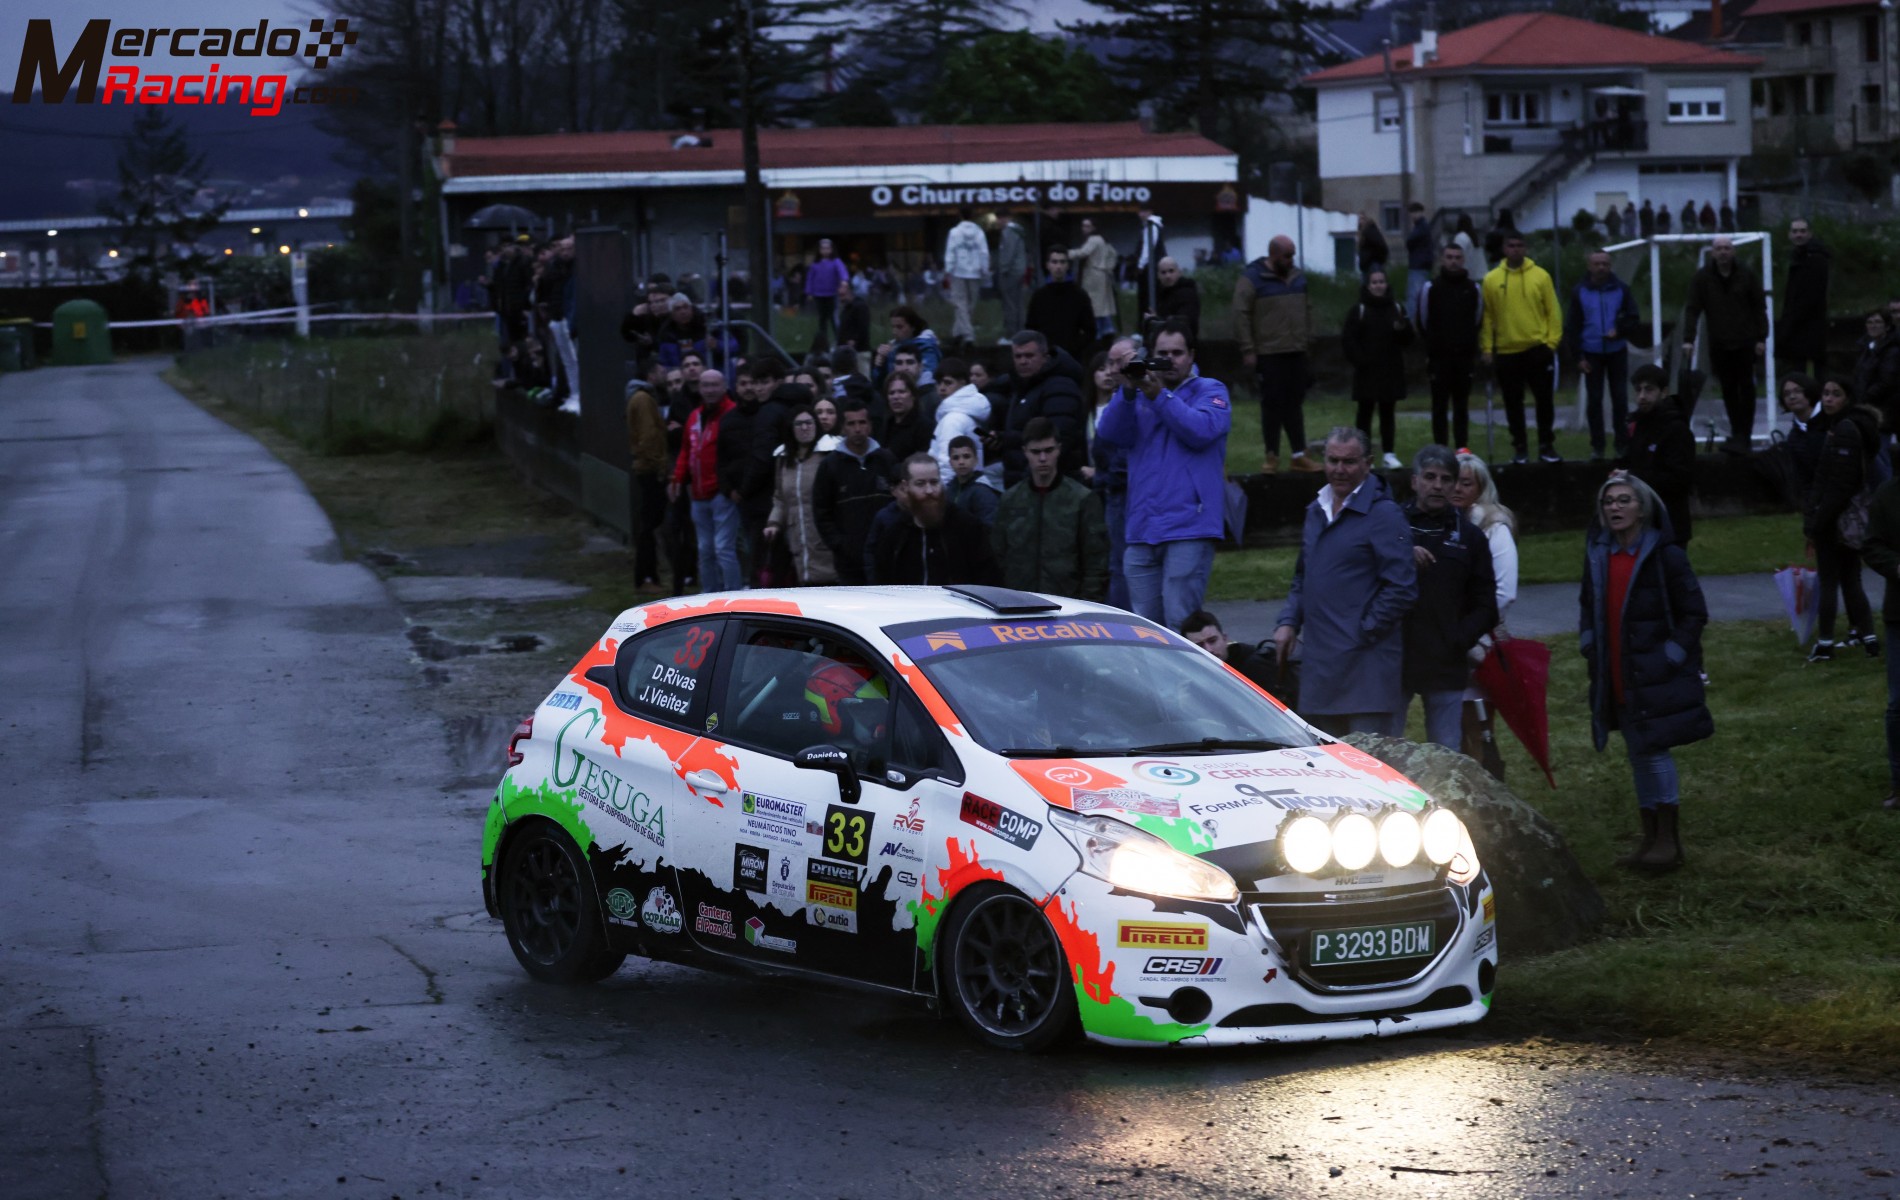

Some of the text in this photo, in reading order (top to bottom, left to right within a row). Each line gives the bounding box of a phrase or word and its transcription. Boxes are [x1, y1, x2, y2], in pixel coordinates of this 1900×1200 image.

[871, 186, 893, 205] O
[1050, 182, 1079, 201] do
[1086, 182, 1151, 201] Floro
[990, 622, 1112, 643] Recalvi
[674, 626, 715, 670] 33
[651, 664, 697, 691] D.Rivas
[546, 692, 583, 711] CREA
[639, 685, 689, 714] J.Vieitez
[807, 751, 838, 760] Daniela
[1207, 767, 1361, 780] CERCEDASOL
[578, 787, 600, 808] GESTORA
[605, 804, 641, 834] SUBPRODUCTOS
[756, 797, 804, 817] EUROMASTER
[747, 819, 797, 837] NEUMÁTICOS TINO
[962, 796, 1039, 840] RACE COMP
[827, 812, 866, 857] 33
[975, 819, 1016, 842] www.racecomp.es
[880, 842, 903, 856] AV
[740, 868, 757, 878] CARS
[741, 857, 765, 872] MIRÓN
[771, 880, 795, 891] Deputación
[809, 883, 853, 907] PIRELLI
[699, 902, 732, 921] Canteras
[696, 917, 737, 939] El Pozo S.L.
[1121, 926, 1206, 946] PIRELLI
[1316, 926, 1430, 961] P 3293 BDM
[1147, 958, 1202, 973] CRS
